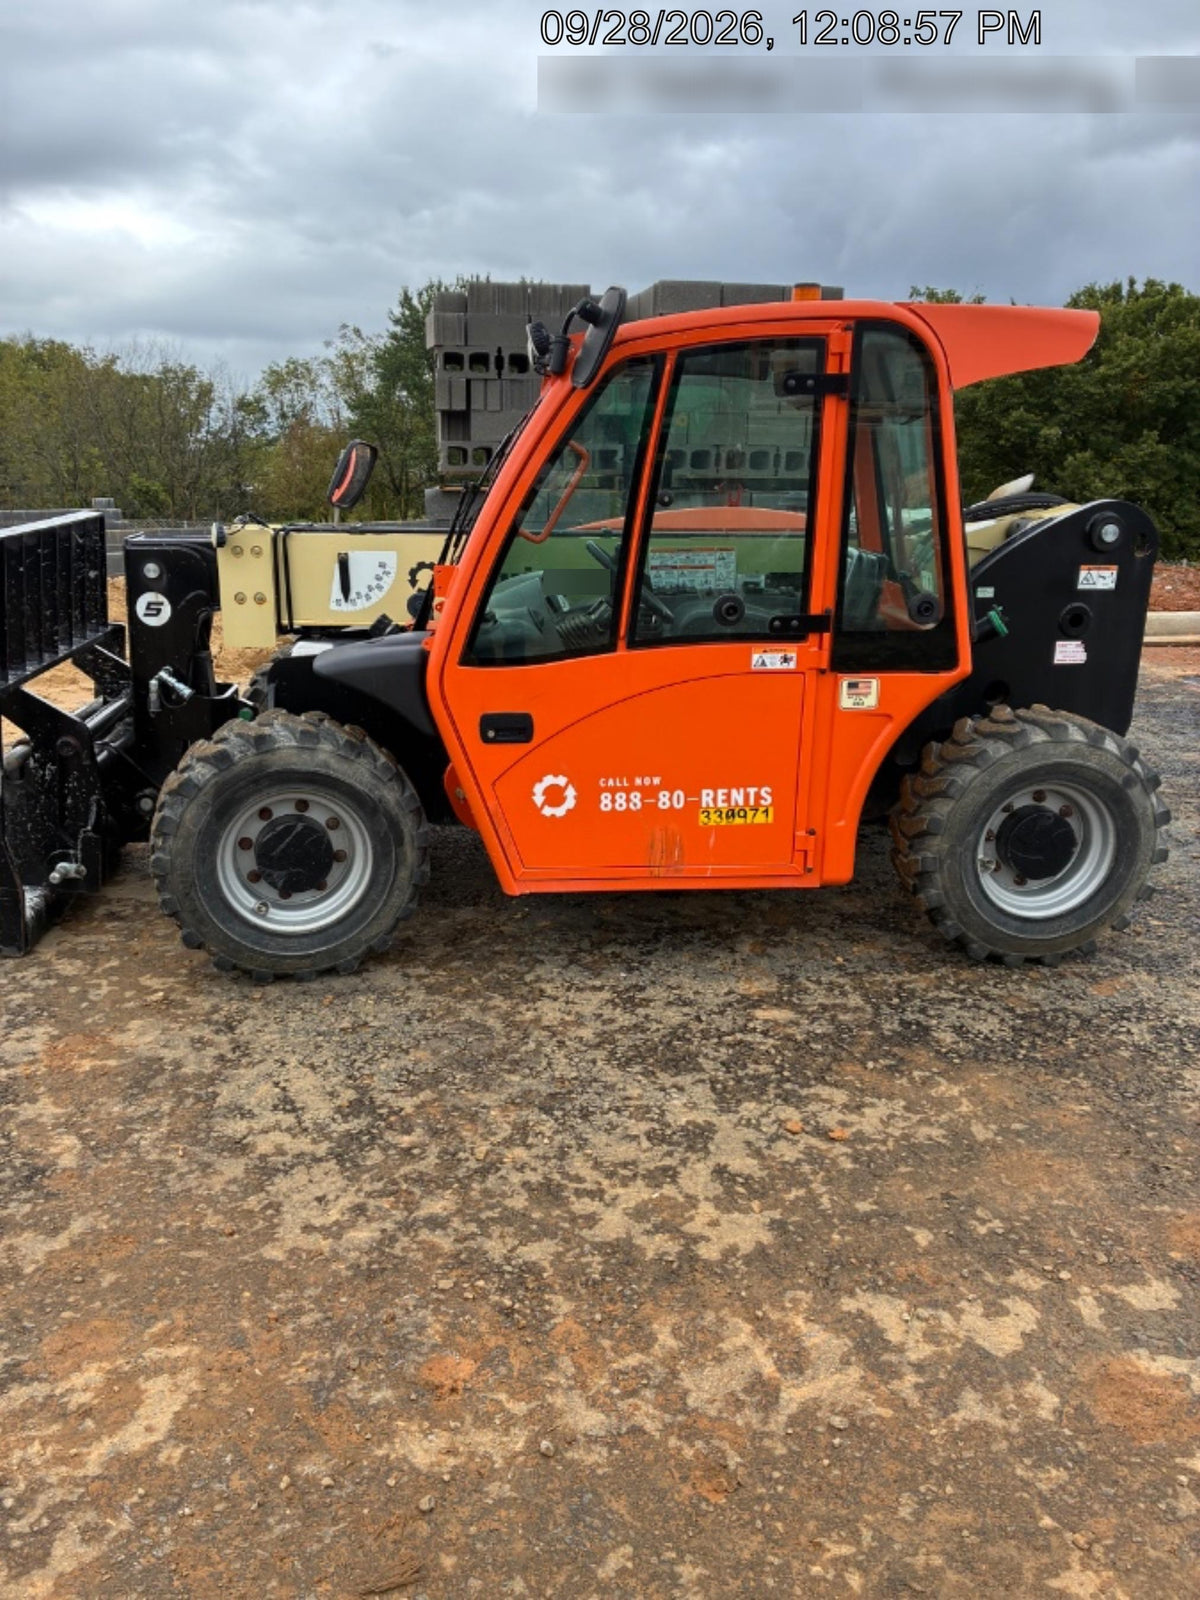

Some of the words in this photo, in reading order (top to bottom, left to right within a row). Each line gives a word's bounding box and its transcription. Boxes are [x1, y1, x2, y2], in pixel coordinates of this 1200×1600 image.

[599, 778, 629, 787] CALL
[635, 776, 662, 786] NOW
[600, 787, 773, 811] 888-80-RENTS
